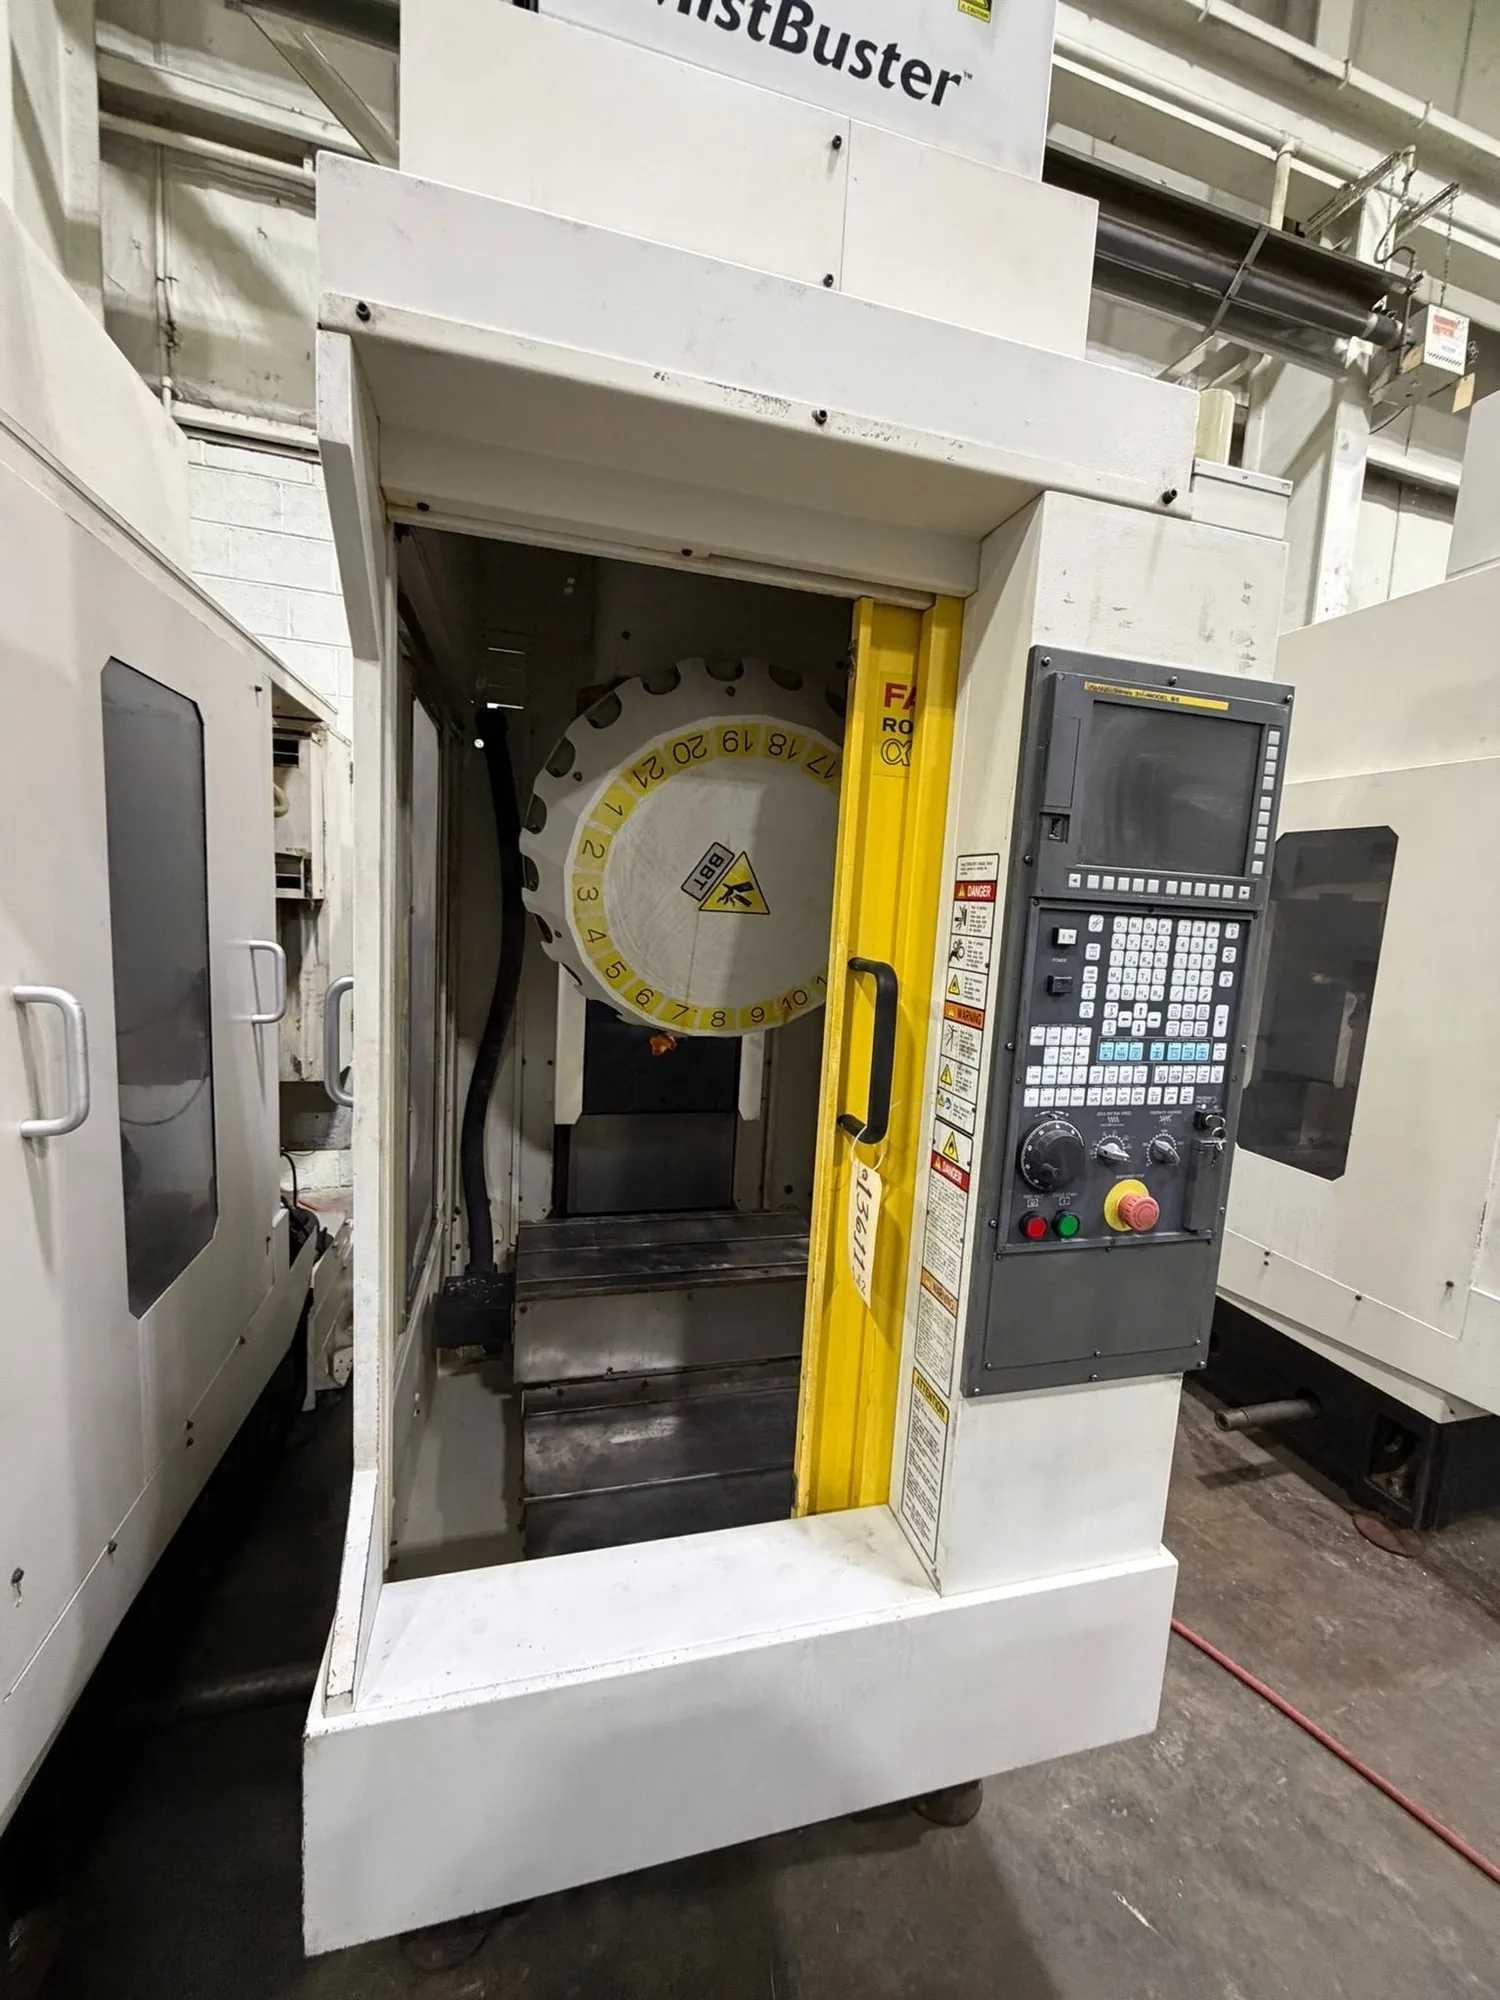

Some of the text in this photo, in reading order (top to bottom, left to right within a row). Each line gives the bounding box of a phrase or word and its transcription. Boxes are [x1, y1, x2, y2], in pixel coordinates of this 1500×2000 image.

[657, 0, 962, 106] stBuster
[672, 734, 708, 765] 20
[722, 729, 753, 753] 19
[768, 732, 797, 760] 18
[632, 756, 665, 789] 21
[807, 754, 838, 780] 17
[604, 802, 624, 817] 1
[583, 838, 605, 859] 2
[693, 852, 724, 892] BBT
[577, 885, 599, 902] 3
[966, 885, 993, 898] DANGER
[586, 927, 608, 944] 4
[606, 960, 628, 980] 5
[635, 987, 655, 1009] 6
[781, 989, 809, 1011] 10
[671, 1003, 690, 1021] 7
[710, 1011, 727, 1028] 8
[749, 1006, 766, 1024] 9
